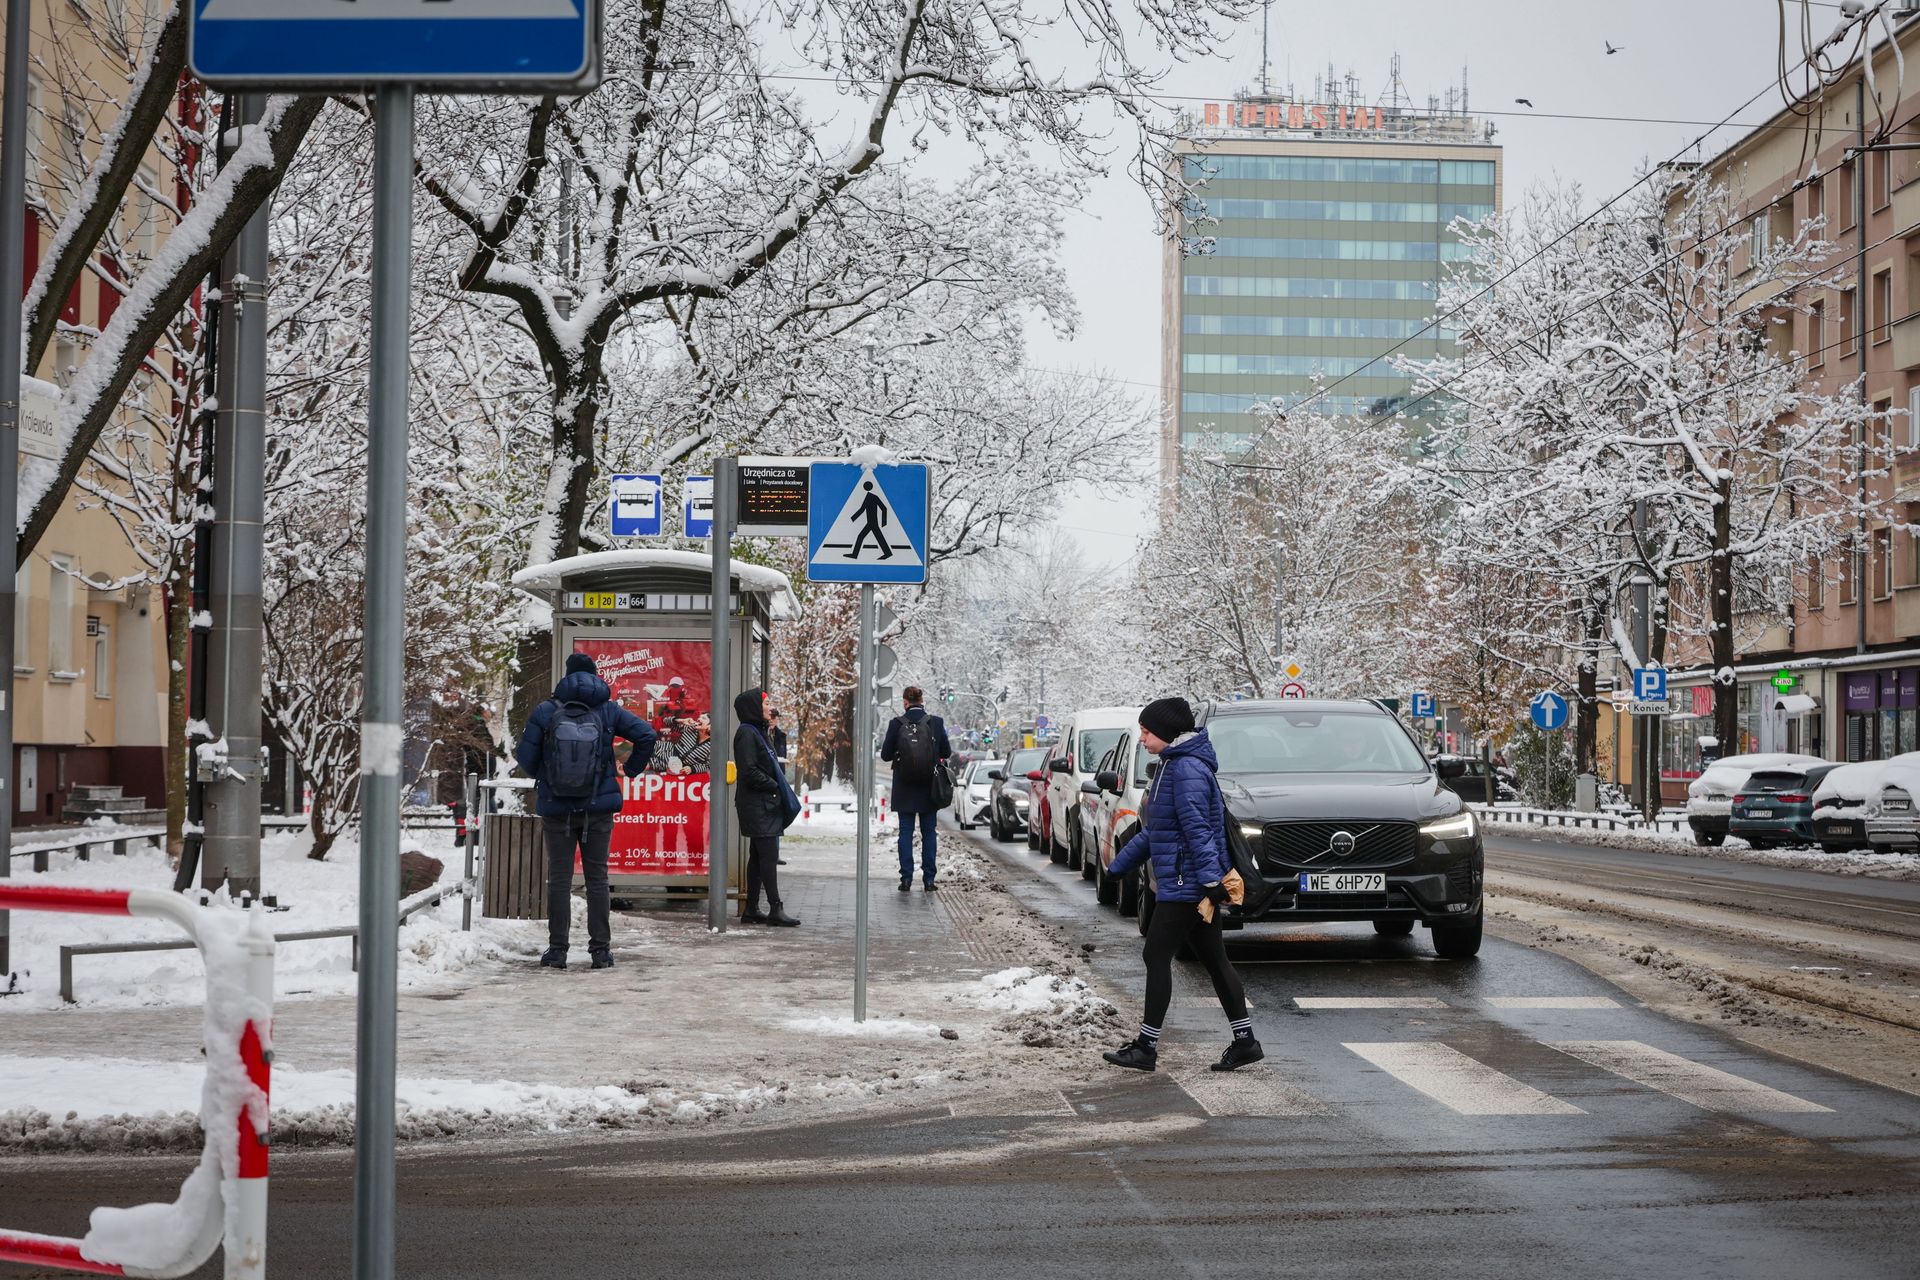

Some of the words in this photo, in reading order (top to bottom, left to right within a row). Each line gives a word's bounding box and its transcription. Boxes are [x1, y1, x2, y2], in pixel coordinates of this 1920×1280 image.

[743, 468, 786, 478] Urzędnicza
[573, 596, 579, 605] 4
[589, 597, 594, 606] 8
[602, 597, 612, 606] 20
[618, 597, 627, 606] 24
[630, 597, 645, 606] 664
[1634, 704, 1665, 713] Koniec
[612, 812, 645, 824] Great
[646, 812, 688, 824] brands
[625, 848, 651, 859] 10%
[1310, 875, 1330, 890] WE
[1335, 875, 1382, 890] 6HP79
